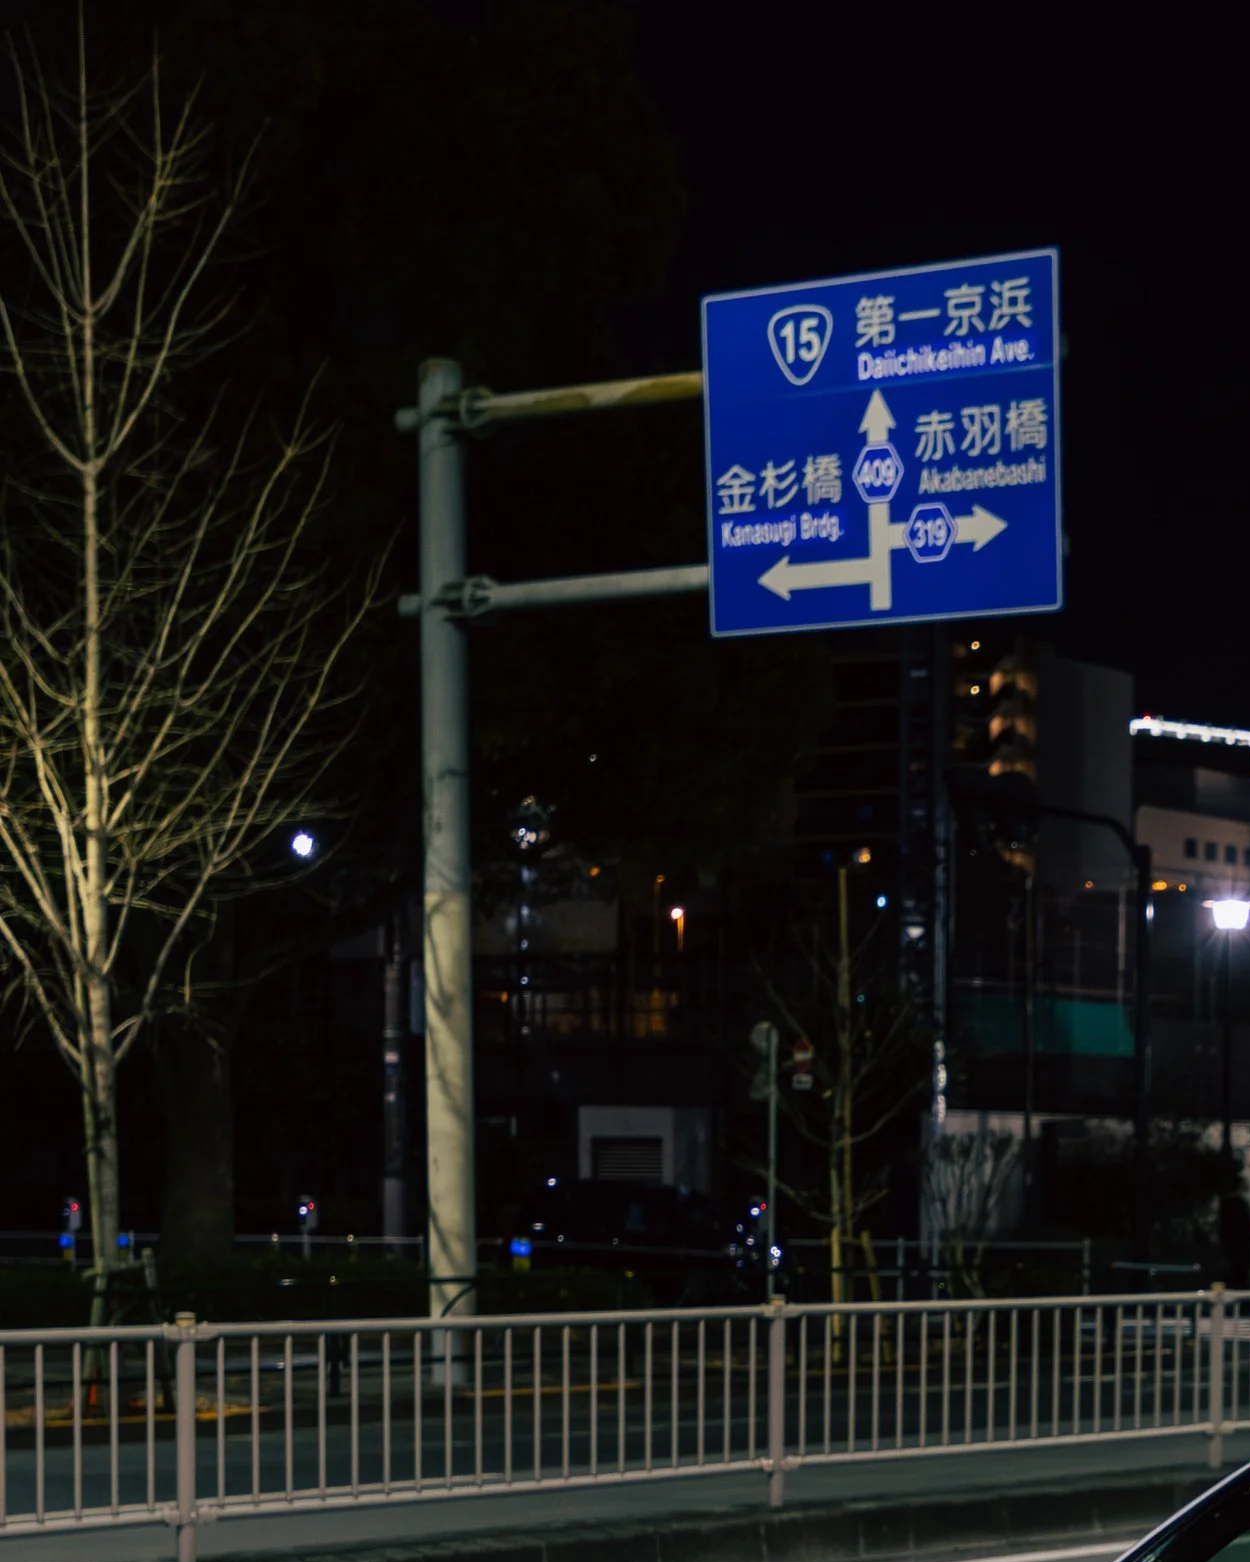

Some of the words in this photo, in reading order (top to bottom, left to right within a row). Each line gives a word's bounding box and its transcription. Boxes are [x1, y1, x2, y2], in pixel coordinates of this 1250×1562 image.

[854, 276, 1034, 348] 第一京浜
[778, 317, 822, 365] 15
[857, 339, 987, 382] Daiichikeihin
[989, 335, 1035, 366] Ave.
[914, 398, 1050, 463] 赤羽橋
[716, 452, 844, 515] 金杉橋
[857, 457, 897, 489] 409
[918, 454, 1047, 495] Akabanebashi
[721, 514, 797, 548] Kanasugi
[912, 516, 948, 549] 319
